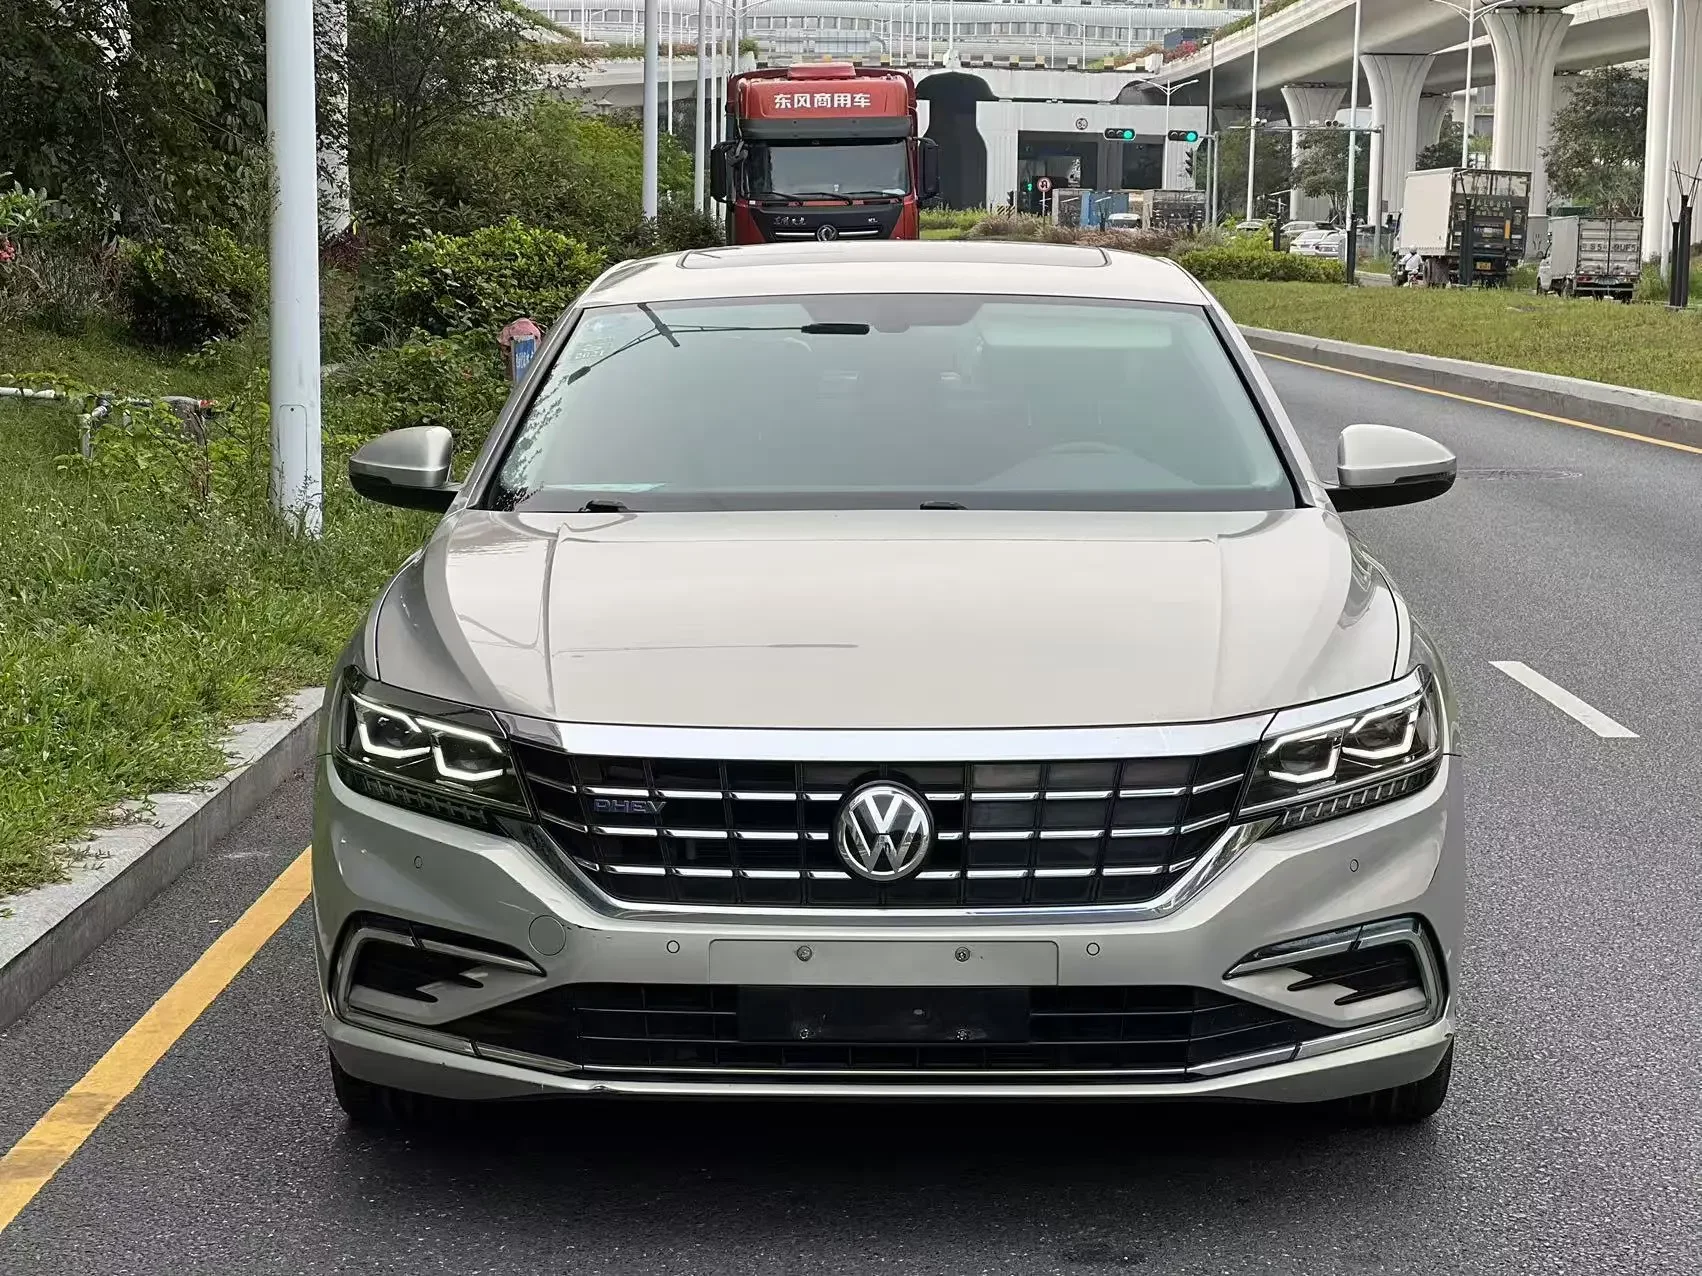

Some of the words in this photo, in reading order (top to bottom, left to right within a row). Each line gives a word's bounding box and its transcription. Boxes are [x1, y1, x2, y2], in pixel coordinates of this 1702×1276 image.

[774, 93, 871, 109] 东风商用车
[594, 799, 667, 813] PHEV
